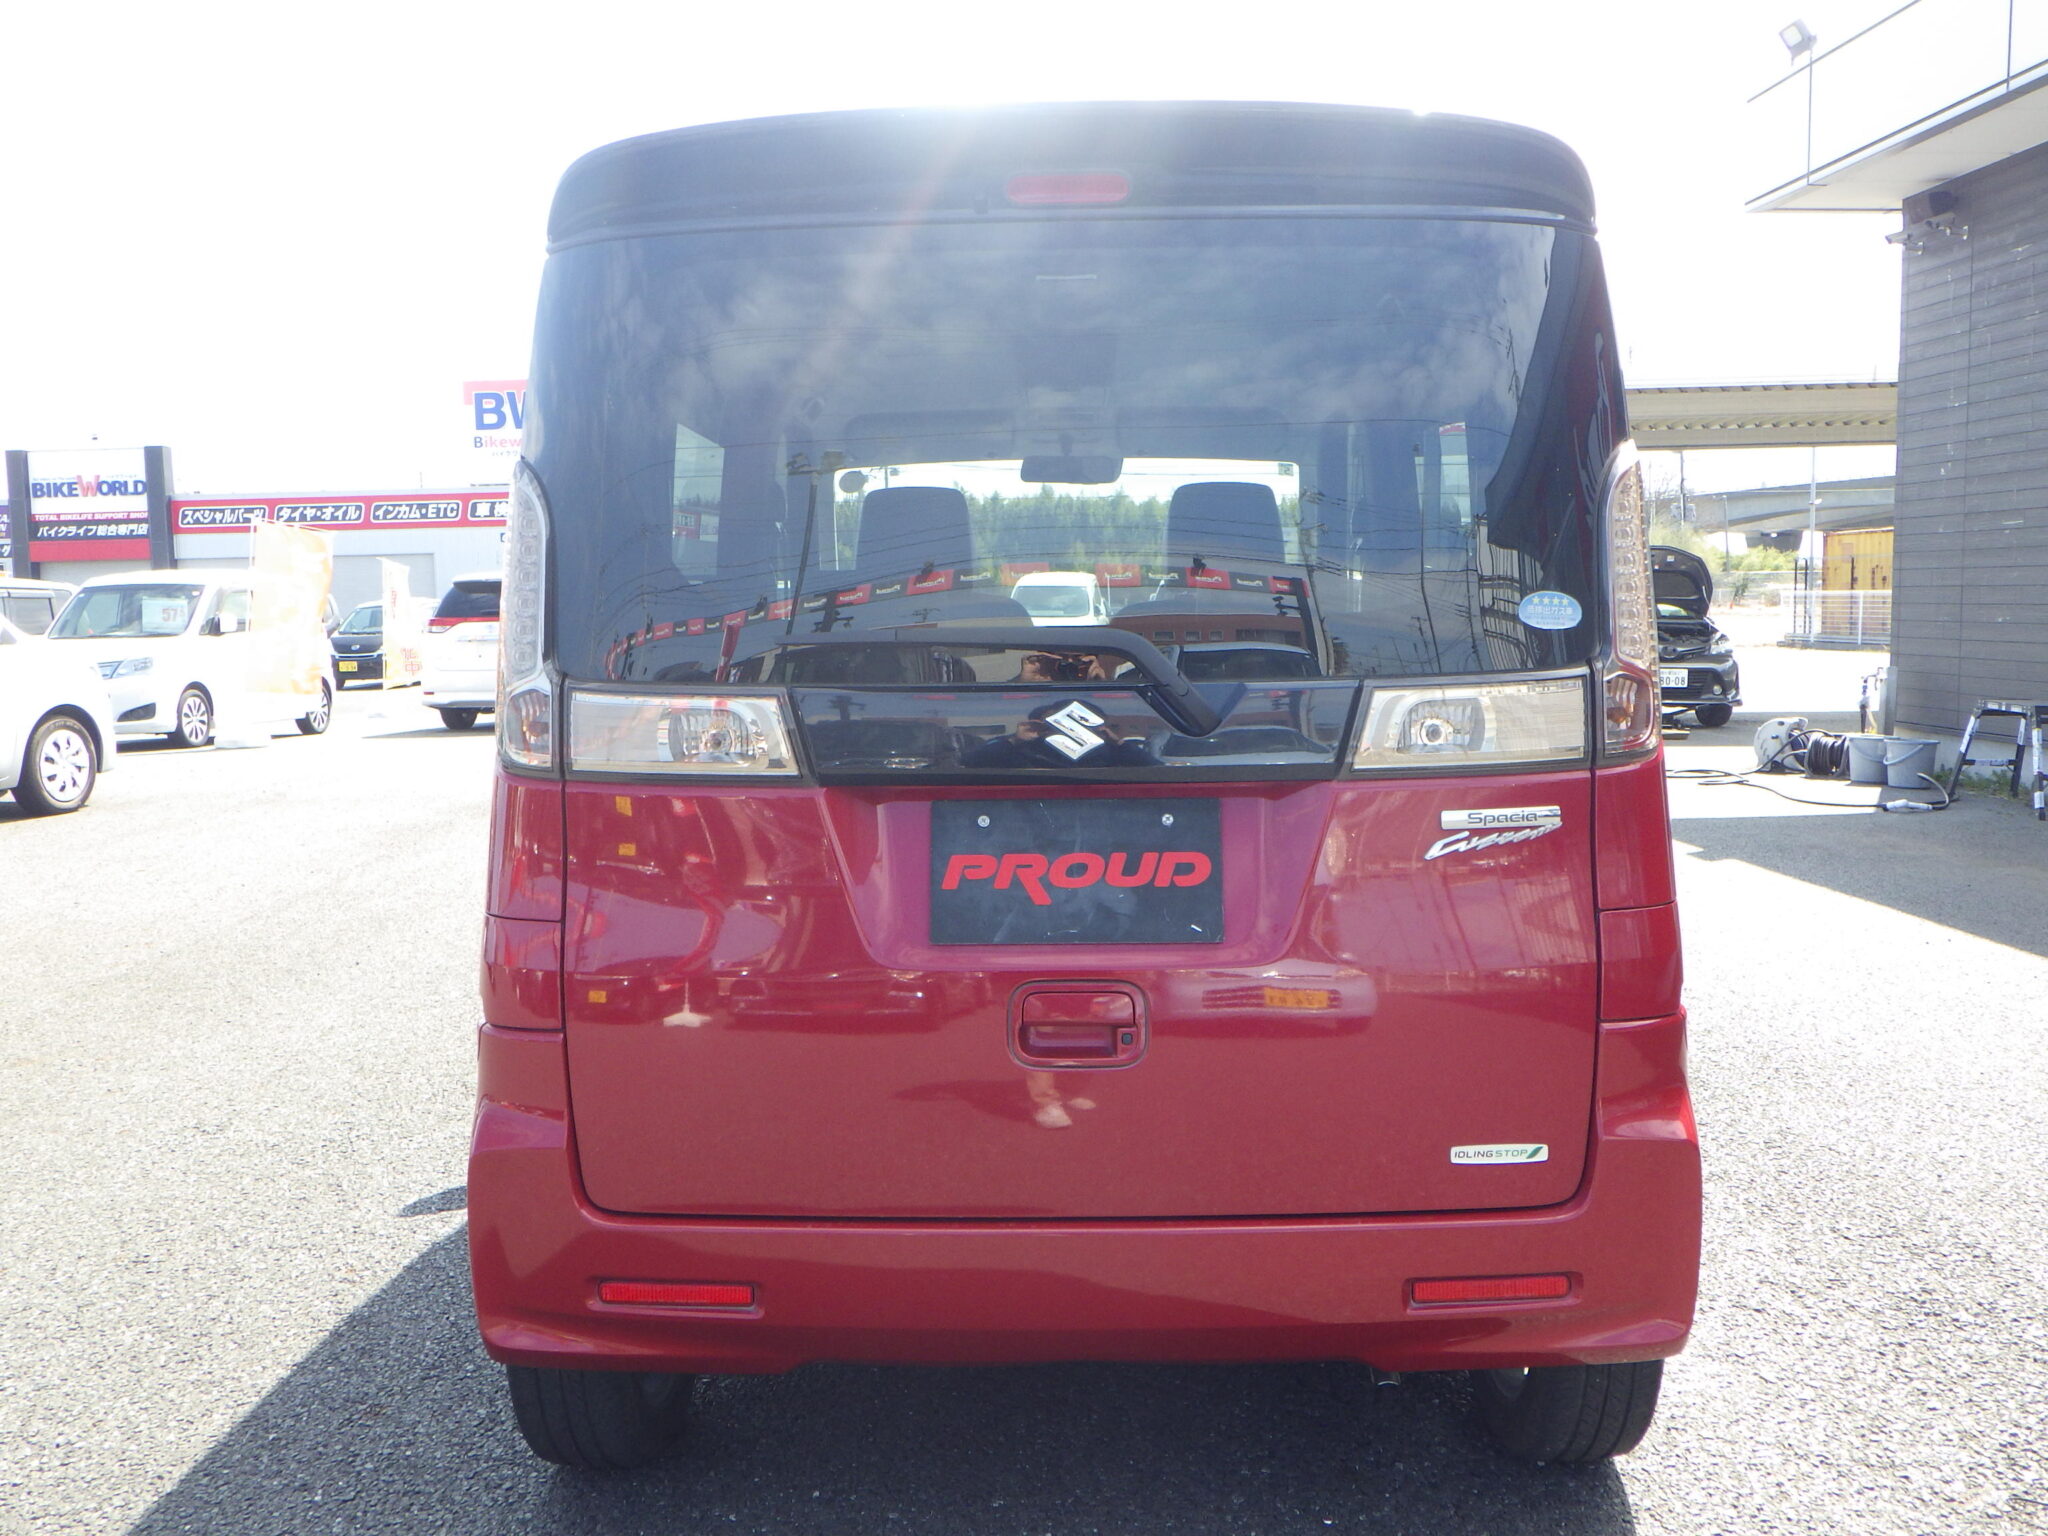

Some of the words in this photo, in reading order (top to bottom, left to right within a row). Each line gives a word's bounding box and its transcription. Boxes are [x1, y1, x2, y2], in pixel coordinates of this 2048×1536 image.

[31, 475, 147, 498] BIKEWORLD
[94, 512, 127, 520] SUPPORT
[37, 524, 148, 537] バイクライフ総合専門店
[1467, 811, 1538, 826] Spacia
[941, 852, 1212, 905] PROUD
